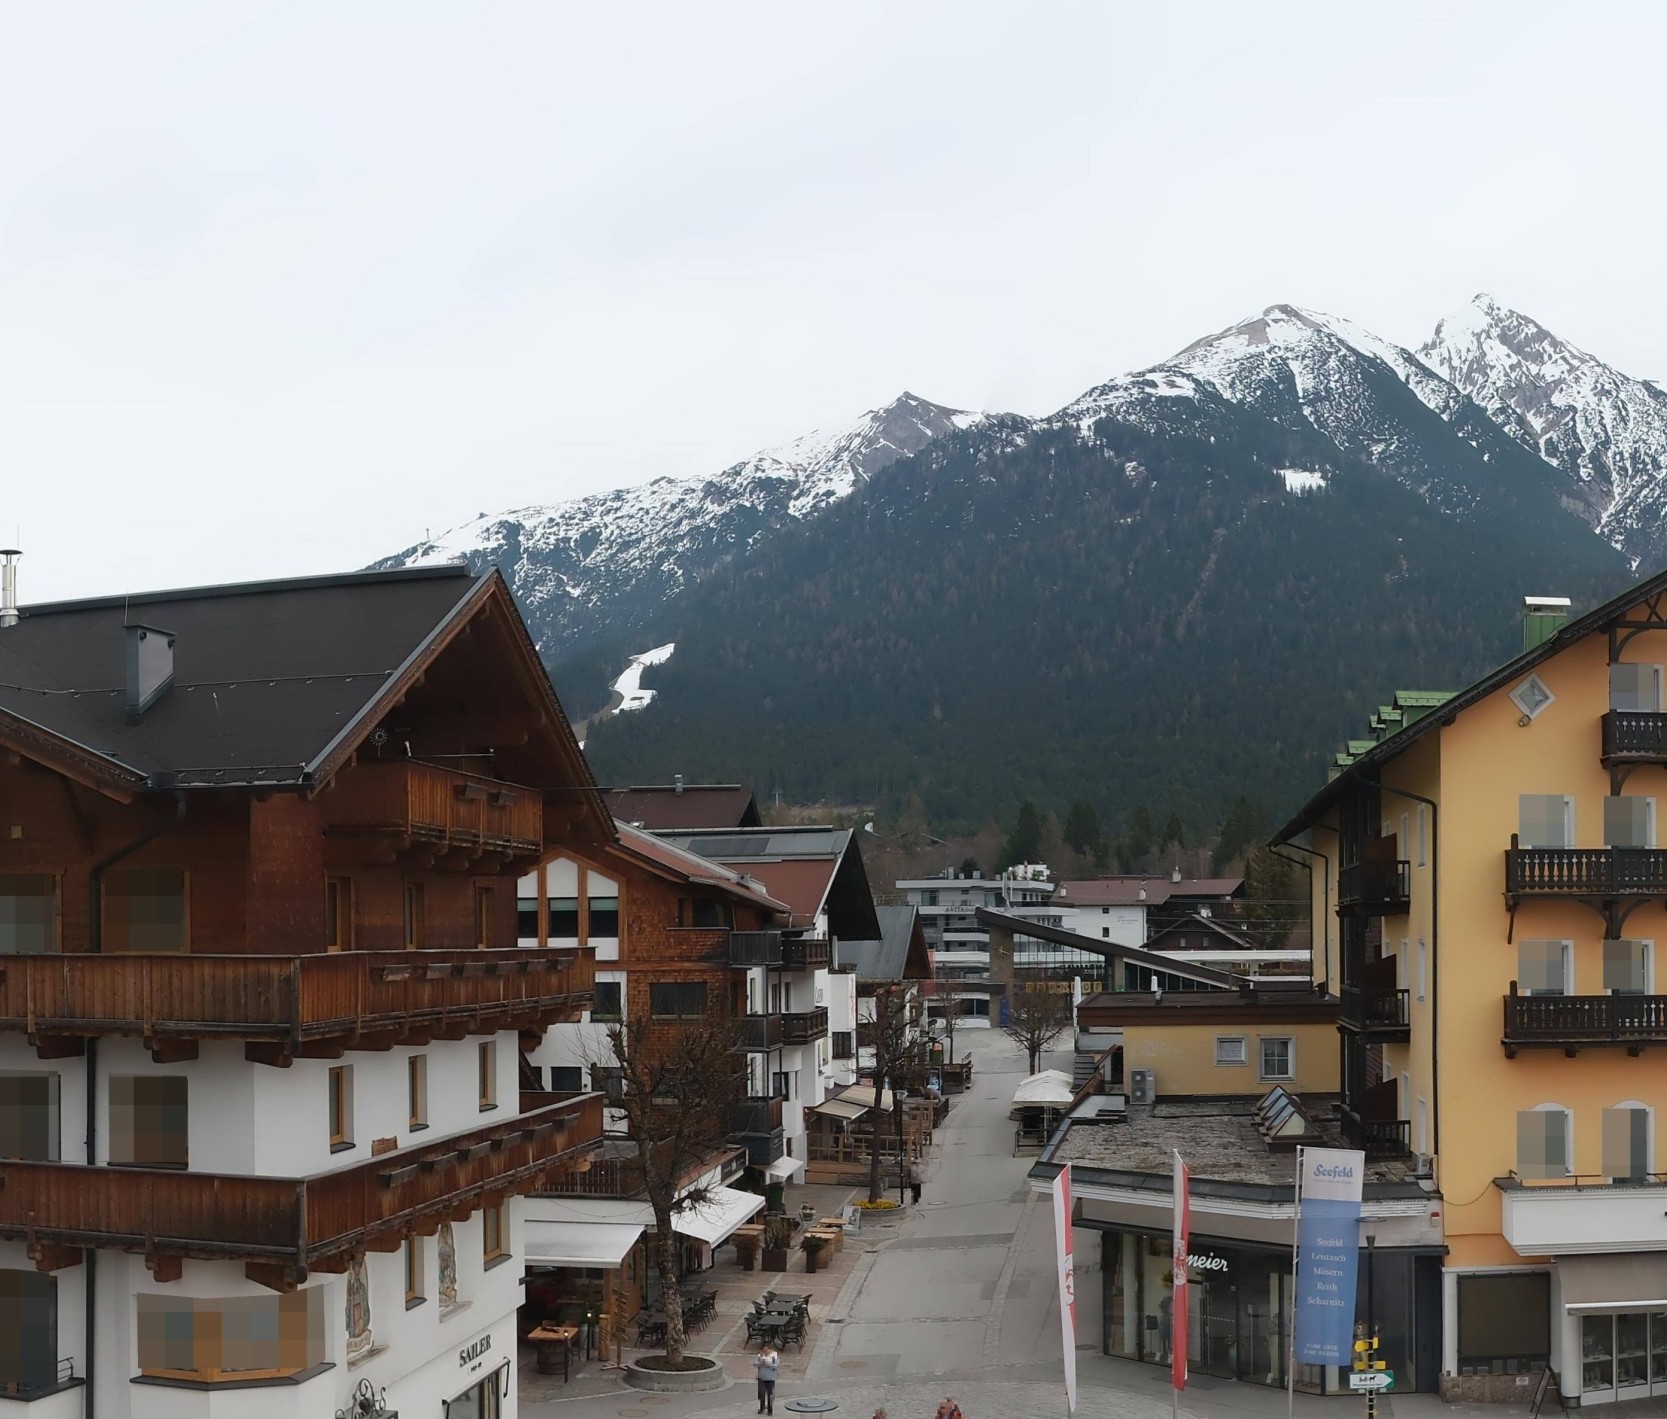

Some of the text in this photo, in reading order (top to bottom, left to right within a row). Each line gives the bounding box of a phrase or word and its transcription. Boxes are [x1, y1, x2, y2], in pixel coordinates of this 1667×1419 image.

[1313, 1163, 1354, 1179] Seefeld
[1316, 1237, 1343, 1248] Seefeld
[1311, 1252, 1346, 1263] Leutasch
[1313, 1266, 1343, 1277] Mösern
[1317, 1281, 1338, 1292] Reith
[1307, 1295, 1345, 1307] Scharnitz
[459, 1334, 492, 1368] SAILER
